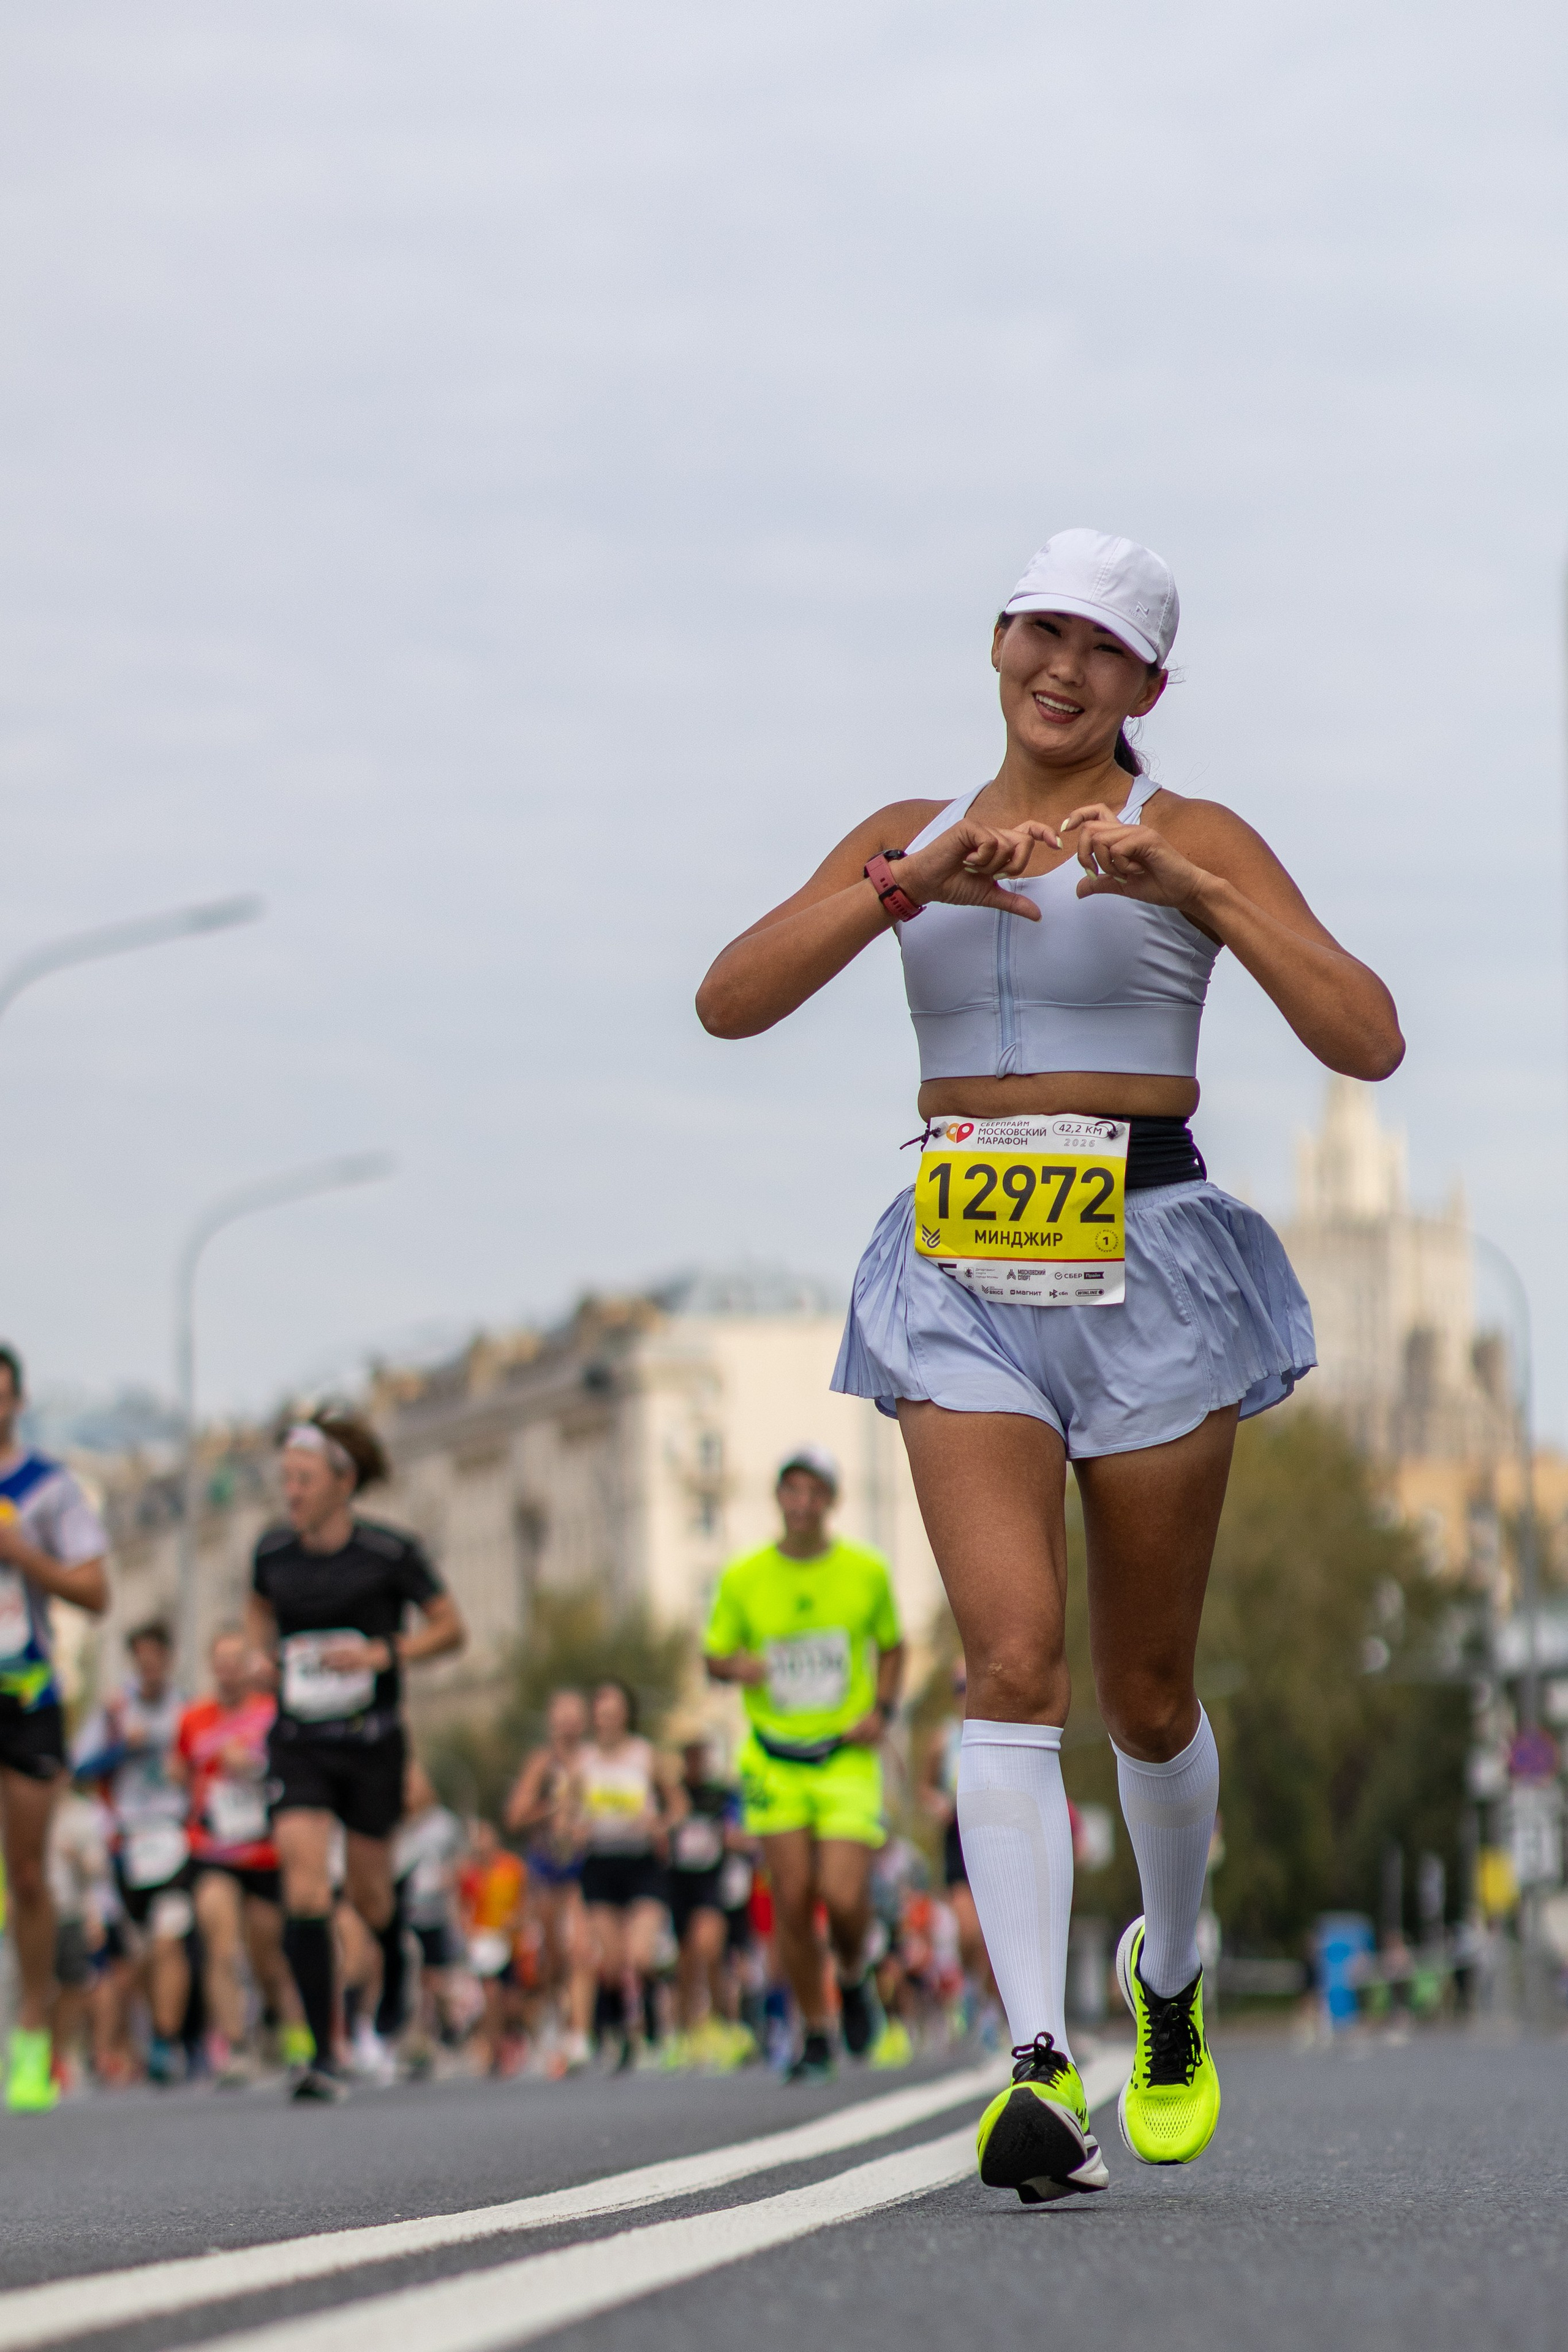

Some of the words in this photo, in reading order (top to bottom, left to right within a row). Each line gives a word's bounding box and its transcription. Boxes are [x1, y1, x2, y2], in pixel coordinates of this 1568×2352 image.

[978, 1127, 1047, 1137] МОСКОВСКИЙ
[1058, 1124, 1082, 1134] 42,2
[977, 1137, 1028, 1145] МАРАФОН
[1063, 1138, 1096, 1148] 2026
[929, 1163, 1115, 1223] 12972
[974, 1229, 1063, 1248] МИНДЖИР
[1102, 1236, 1109, 1245] 1
